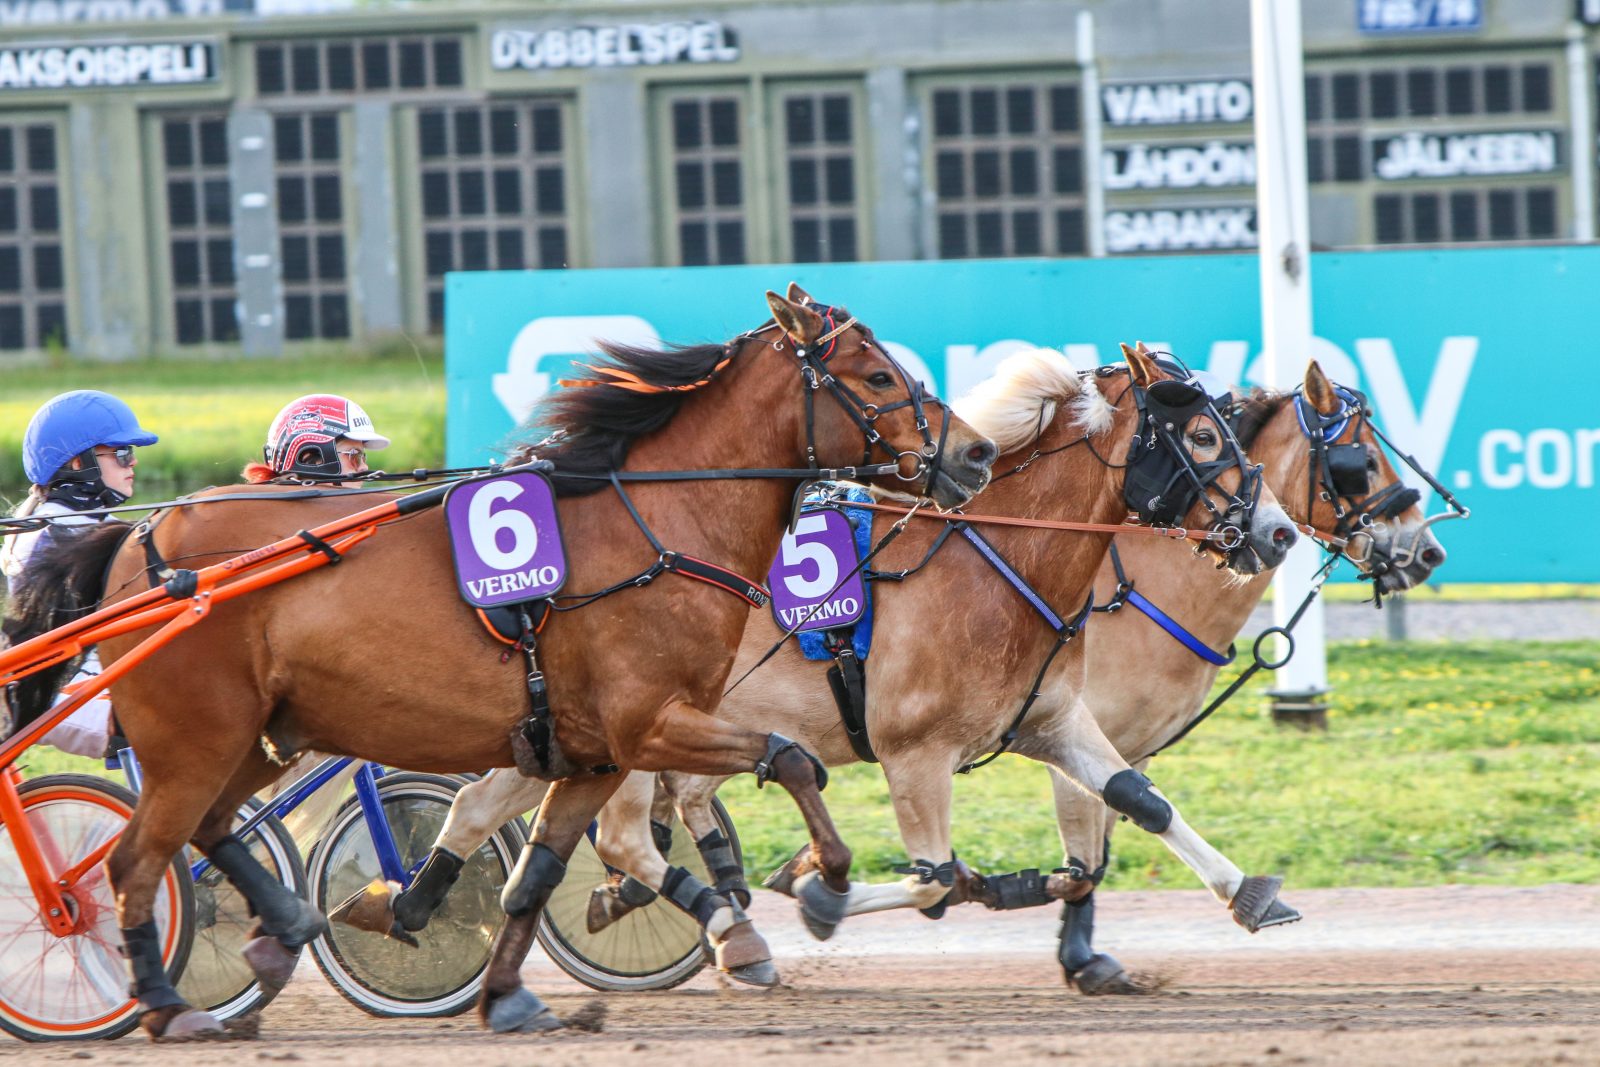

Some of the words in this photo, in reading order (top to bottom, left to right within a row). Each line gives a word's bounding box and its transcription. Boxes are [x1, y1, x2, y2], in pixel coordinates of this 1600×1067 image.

[1103, 80, 1251, 125] VAIHTO
[468, 480, 538, 571] 6
[781, 514, 838, 599] 5
[466, 565, 559, 599] VERMO
[780, 597, 858, 626] VERMO
